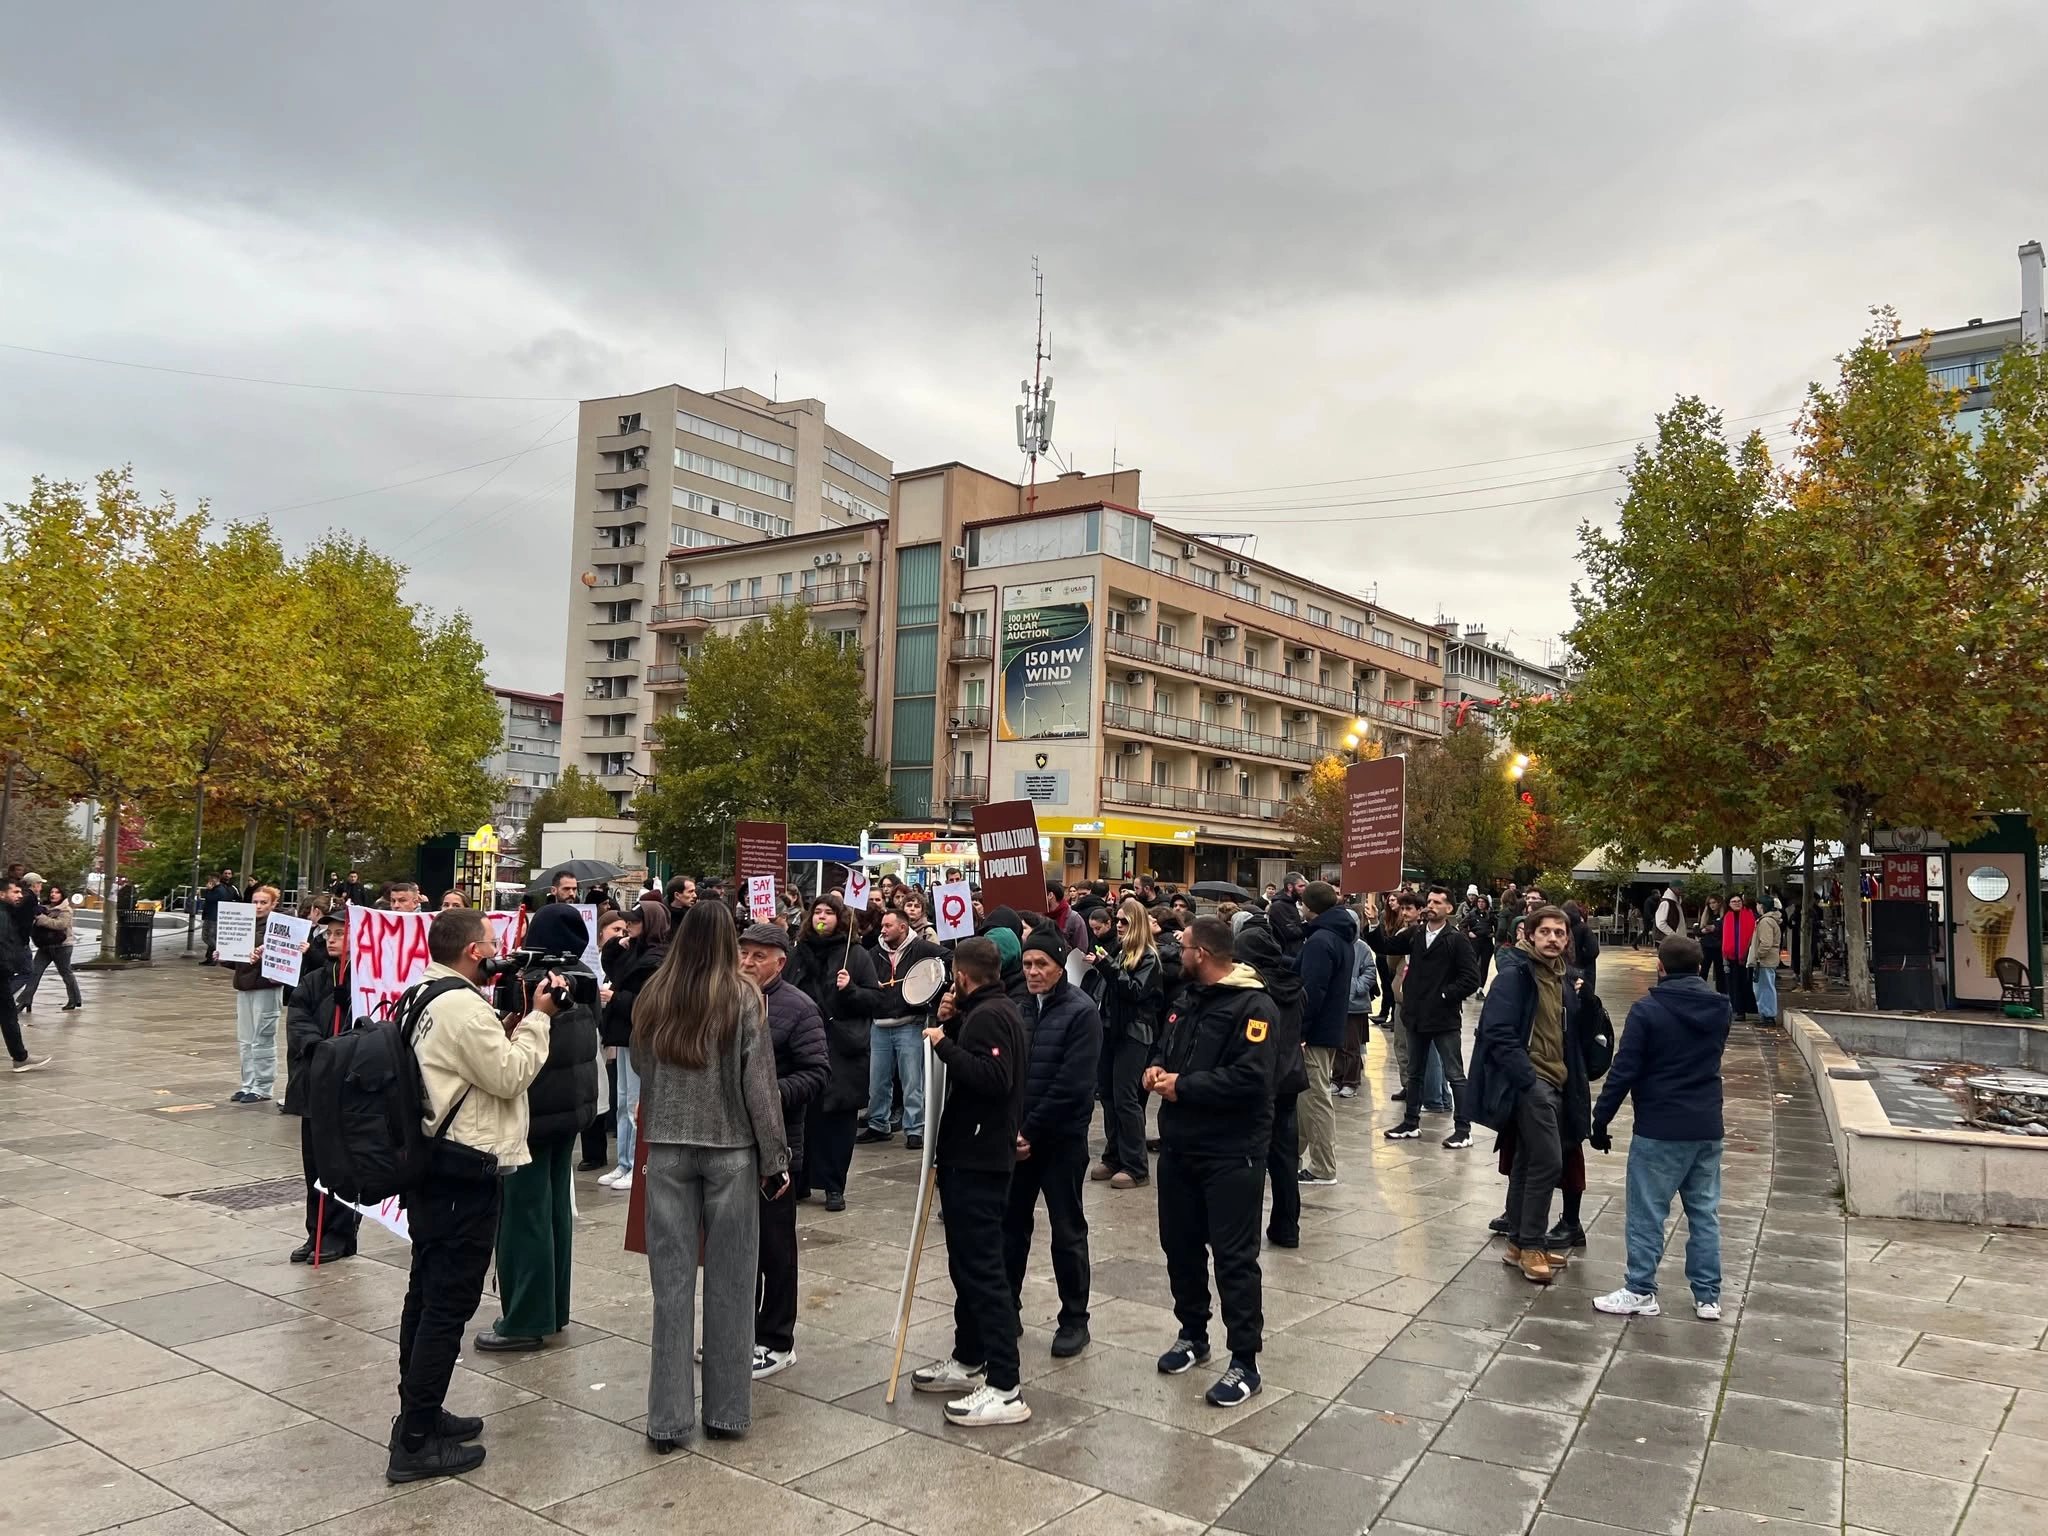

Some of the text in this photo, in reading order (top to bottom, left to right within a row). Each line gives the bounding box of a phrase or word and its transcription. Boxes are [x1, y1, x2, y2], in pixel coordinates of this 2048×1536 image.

[1008, 611, 1041, 623] 100 MW
[1008, 621, 1038, 632] SOLAR
[1006, 628, 1050, 641] AUCTION
[1025, 647, 1084, 667] 150 MW
[1025, 665, 1072, 682] WIND
[980, 827, 1036, 853] ULTIMATUMI
[983, 855, 1028, 879] I POPULLIT
[1887, 860, 1919, 873] Pulë
[753, 879, 771, 891] SAY
[1897, 874, 1913, 883] për
[1889, 884, 1921, 898] Pulë
[754, 893, 771, 905] HER
[268, 922, 274, 934] O
